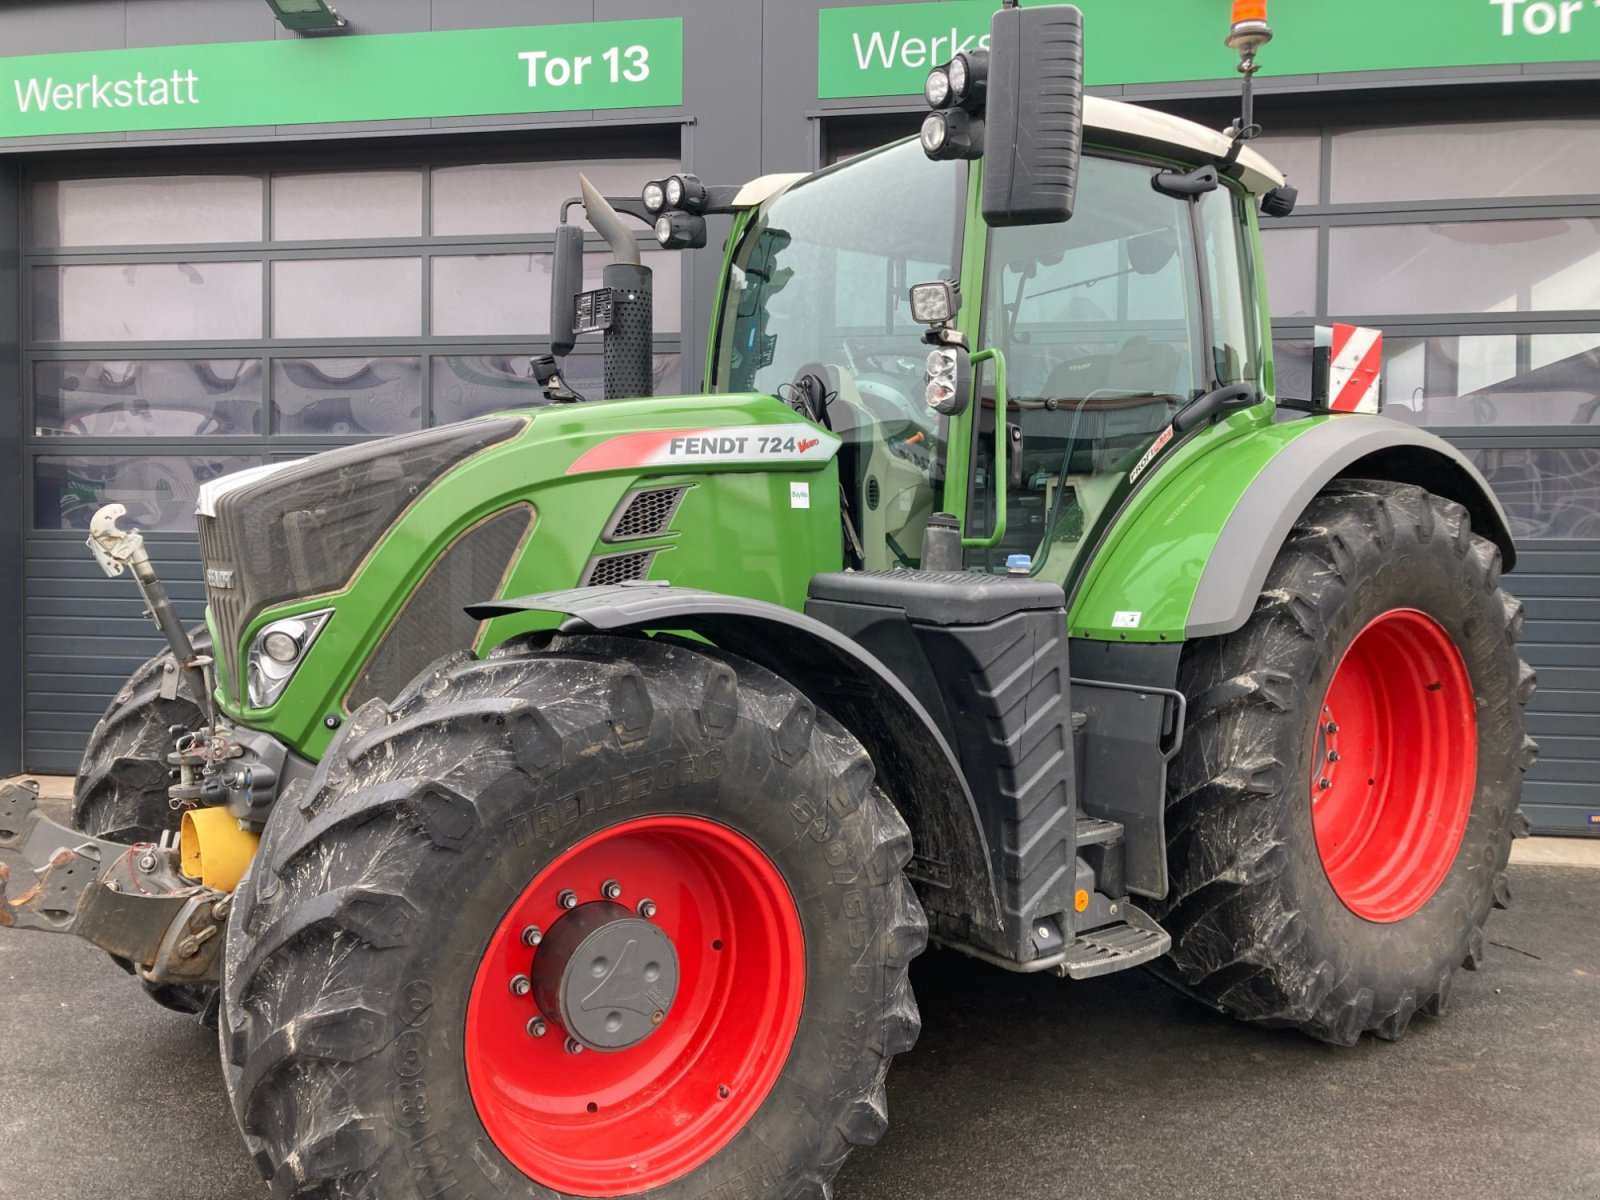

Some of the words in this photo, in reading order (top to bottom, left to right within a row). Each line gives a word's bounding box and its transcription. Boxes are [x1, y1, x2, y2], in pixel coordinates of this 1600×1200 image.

[1489, 0, 1583, 36] Tor
[517, 50, 592, 87] Tor
[601, 45, 650, 83] 13
[14, 68, 199, 113] Werkstatt
[670, 437, 749, 455] FENDT
[758, 436, 796, 453] 724
[503, 747, 723, 849] TRELLEBORG
